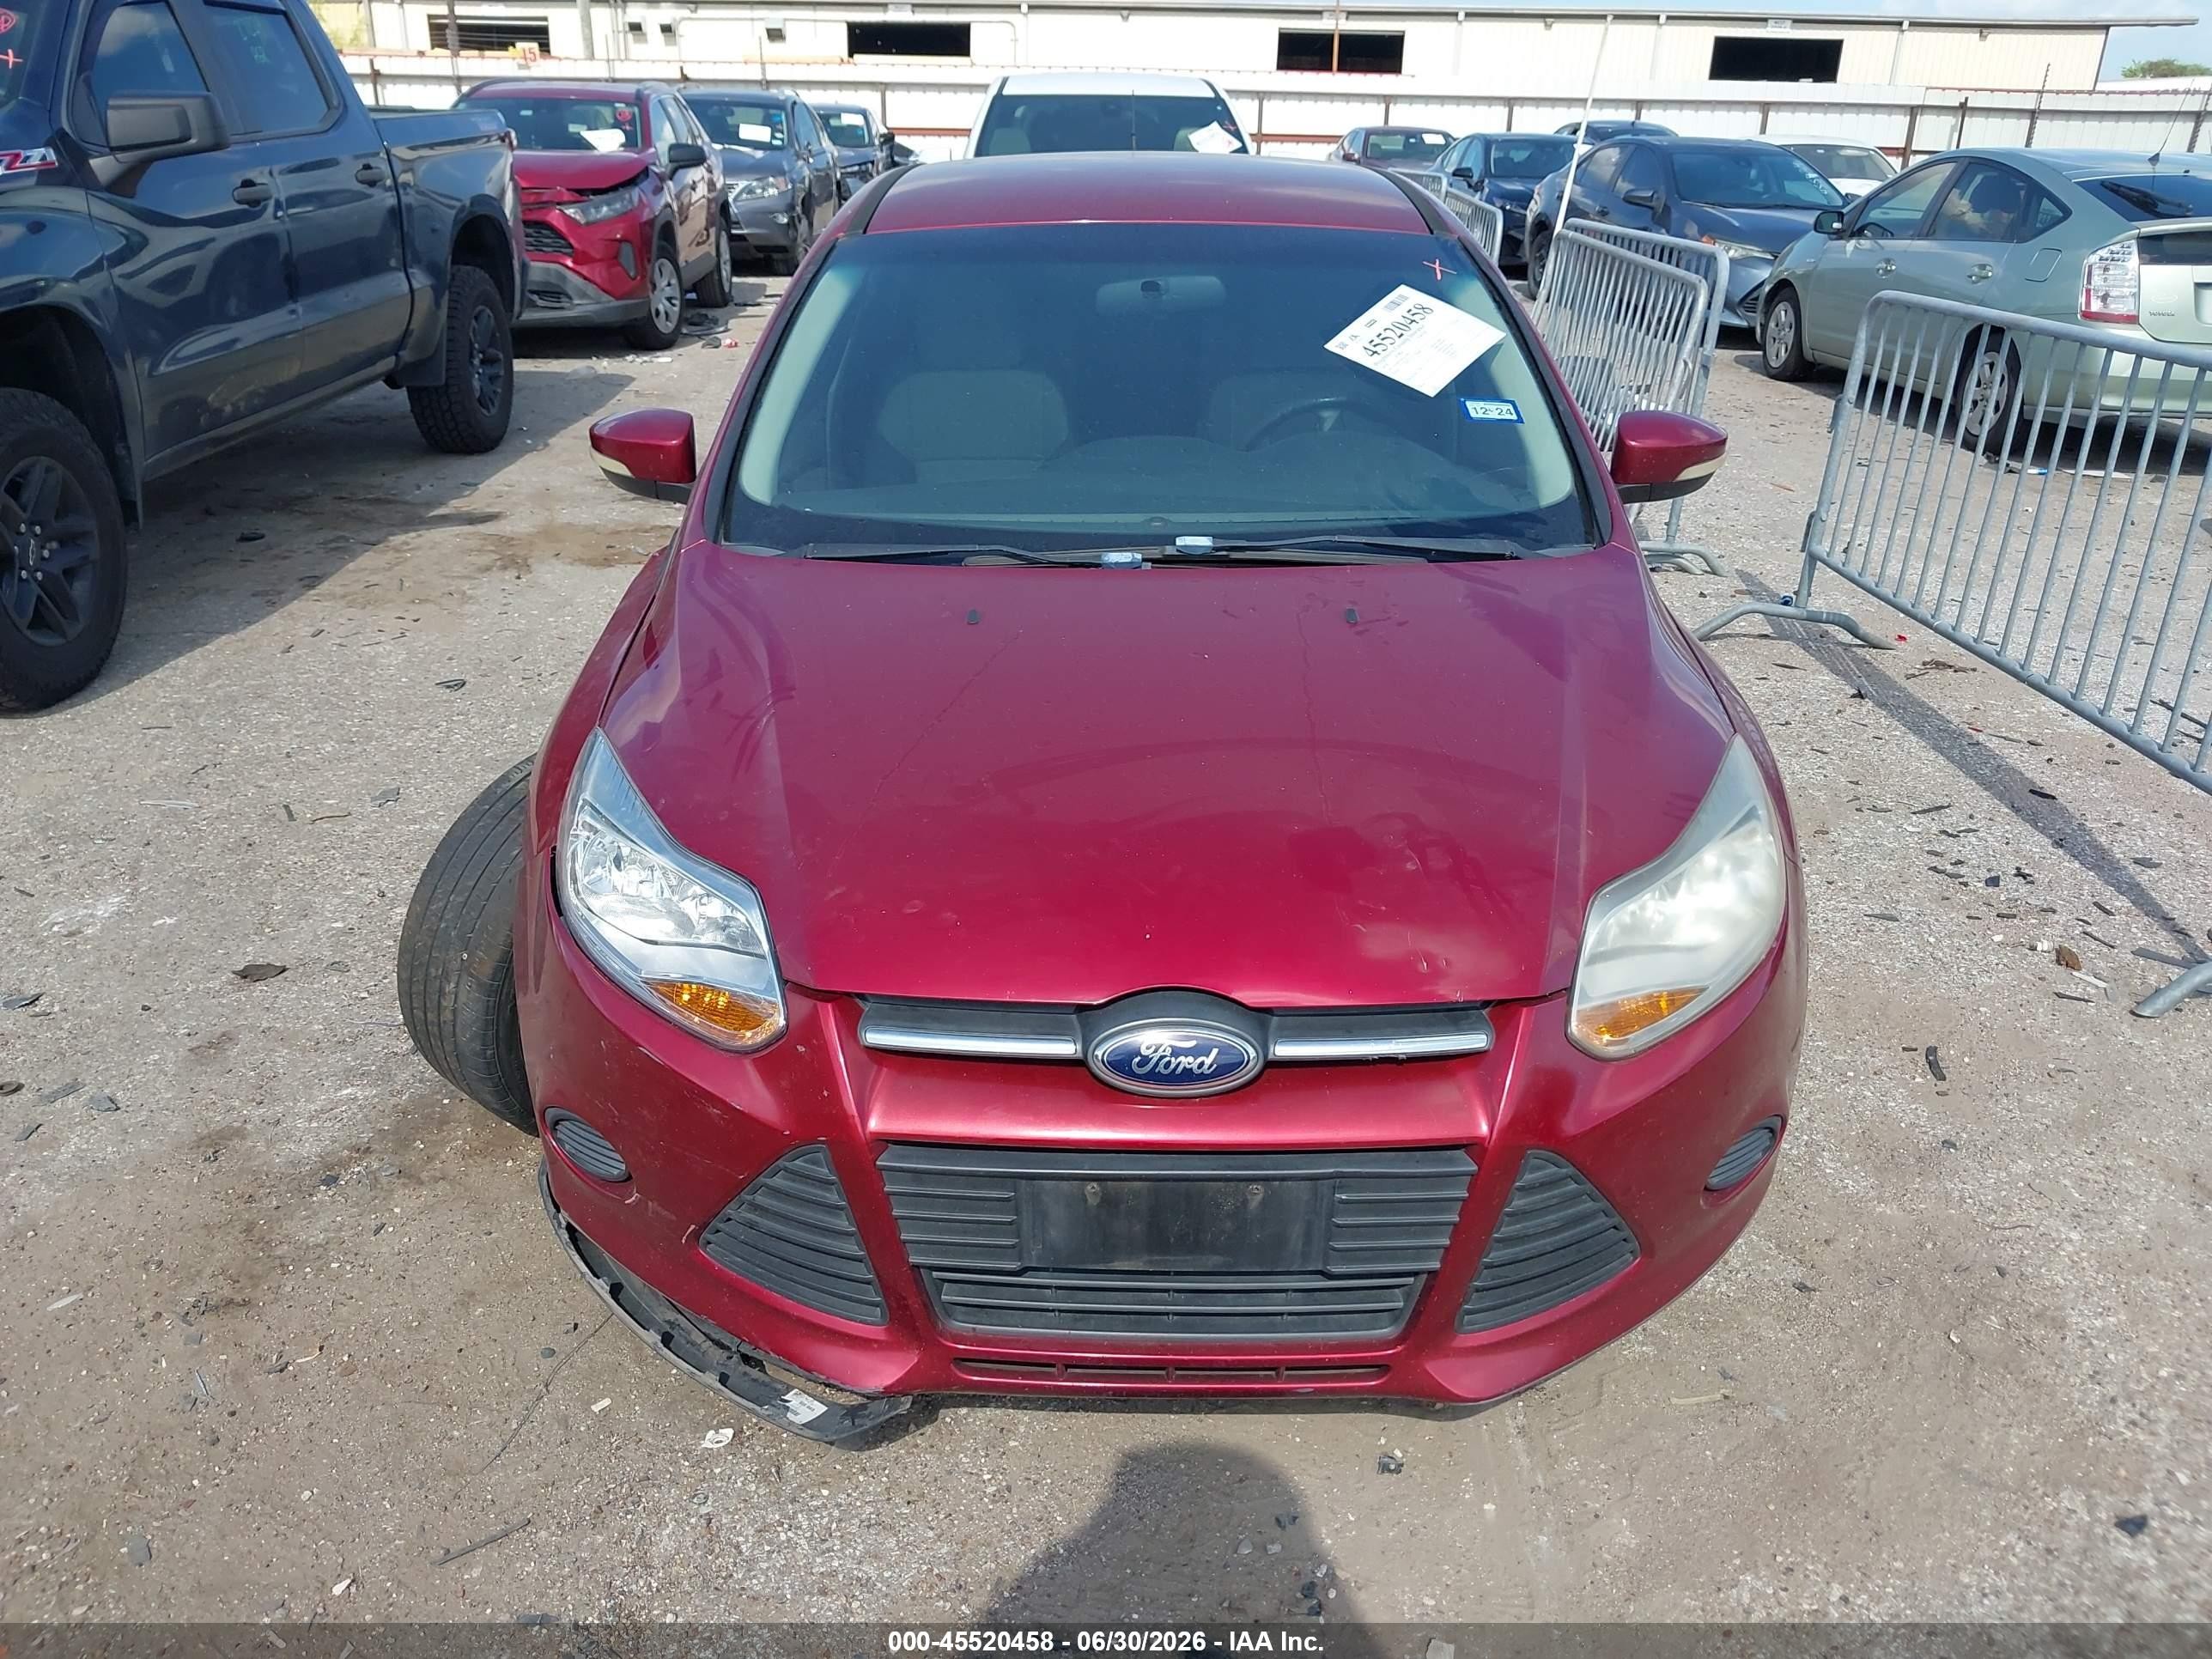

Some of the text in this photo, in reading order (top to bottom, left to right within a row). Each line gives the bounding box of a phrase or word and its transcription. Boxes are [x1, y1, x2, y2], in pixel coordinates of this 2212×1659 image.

[1362, 303, 1434, 357] 45520458
[1472, 406, 1514, 416] 12 24
[1132, 1037, 1219, 1074] Ford
